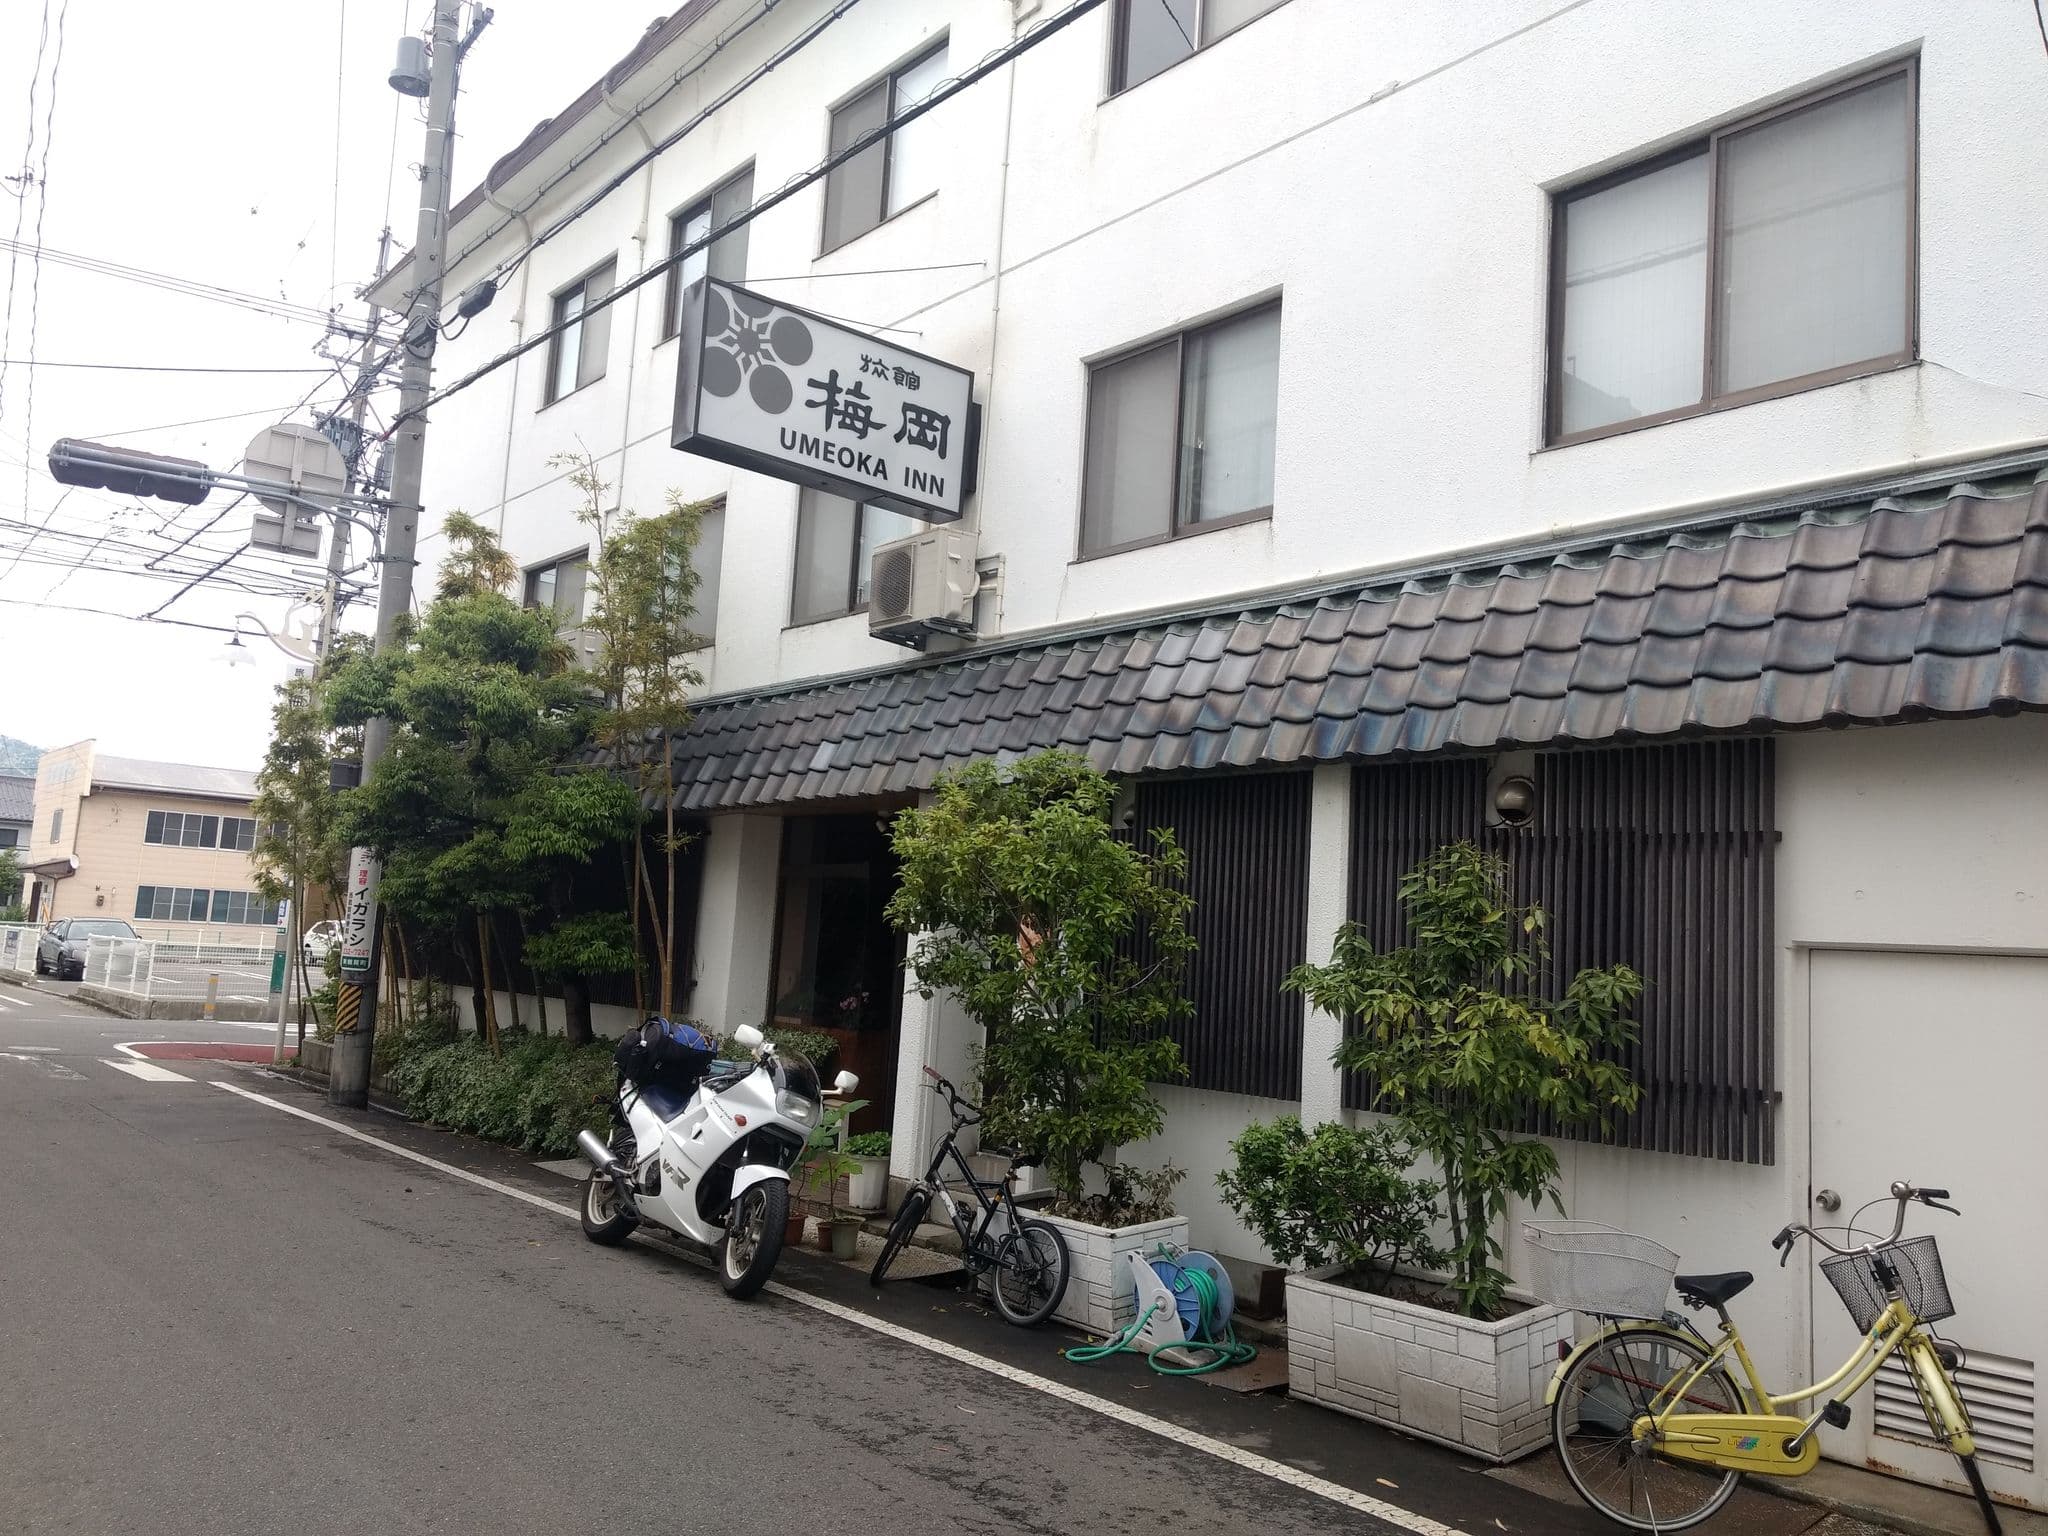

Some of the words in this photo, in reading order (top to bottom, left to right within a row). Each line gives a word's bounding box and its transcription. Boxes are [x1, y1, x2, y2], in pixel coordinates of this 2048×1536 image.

[805, 369, 951, 460] 梅岡
[780, 427, 889, 480] UMEOKA
[903, 466, 945, 498] INN
[350, 887, 369, 946] イガラシ
